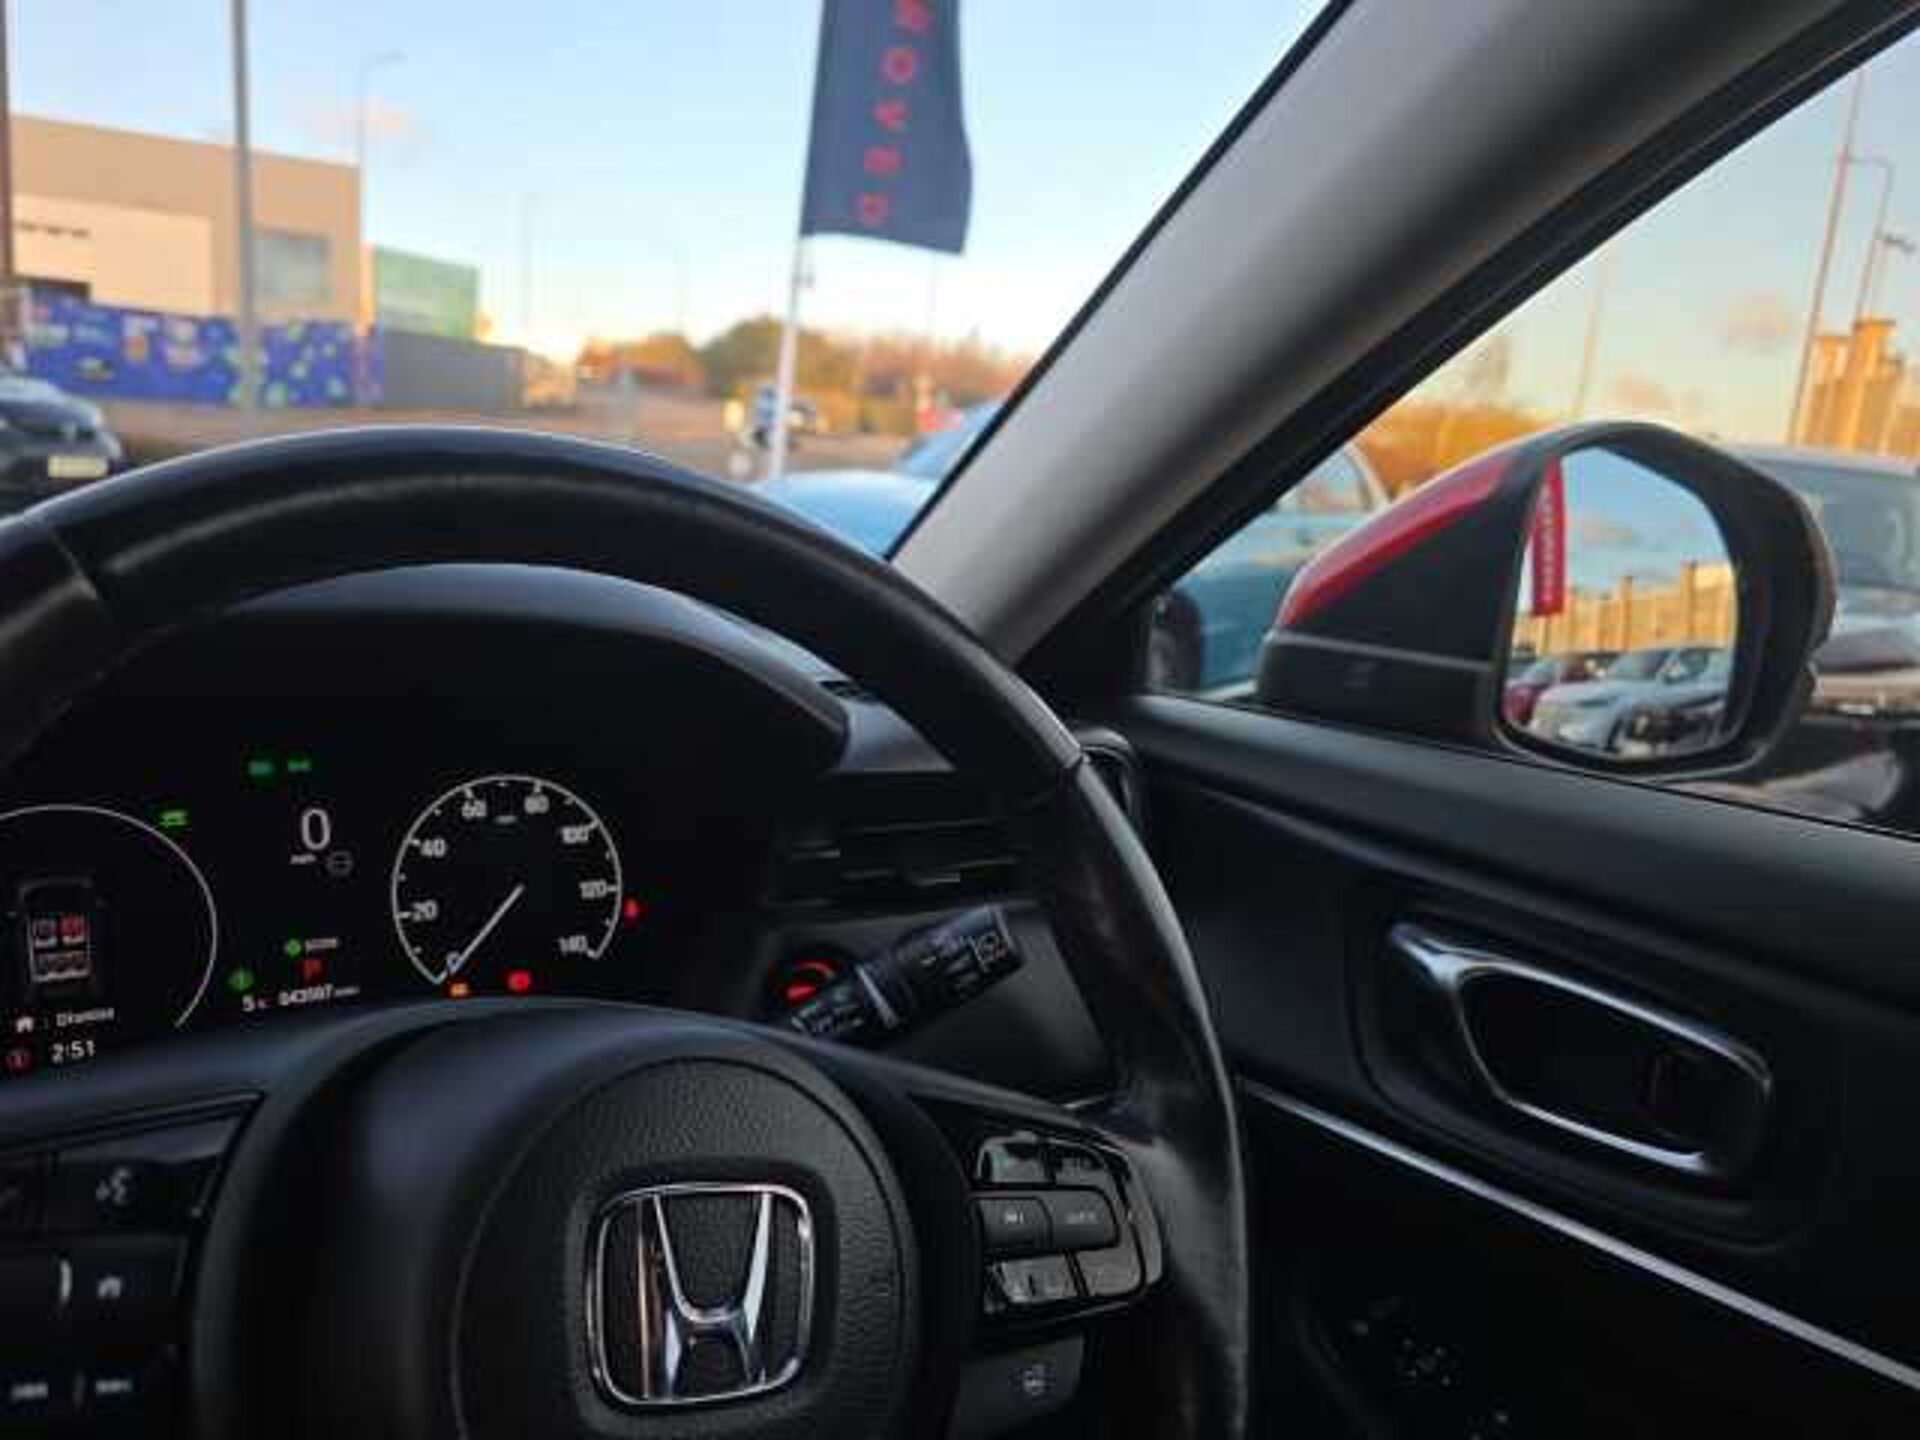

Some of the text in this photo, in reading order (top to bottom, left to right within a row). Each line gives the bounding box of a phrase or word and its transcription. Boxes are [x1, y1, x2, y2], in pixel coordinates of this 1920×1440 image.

[302, 808, 330, 850] 0
[560, 825, 589, 845] 100
[420, 838, 447, 857] 40
[578, 880, 607, 899] 120
[412, 900, 438, 921] 20
[51, 1040, 95, 1064] 2:51
